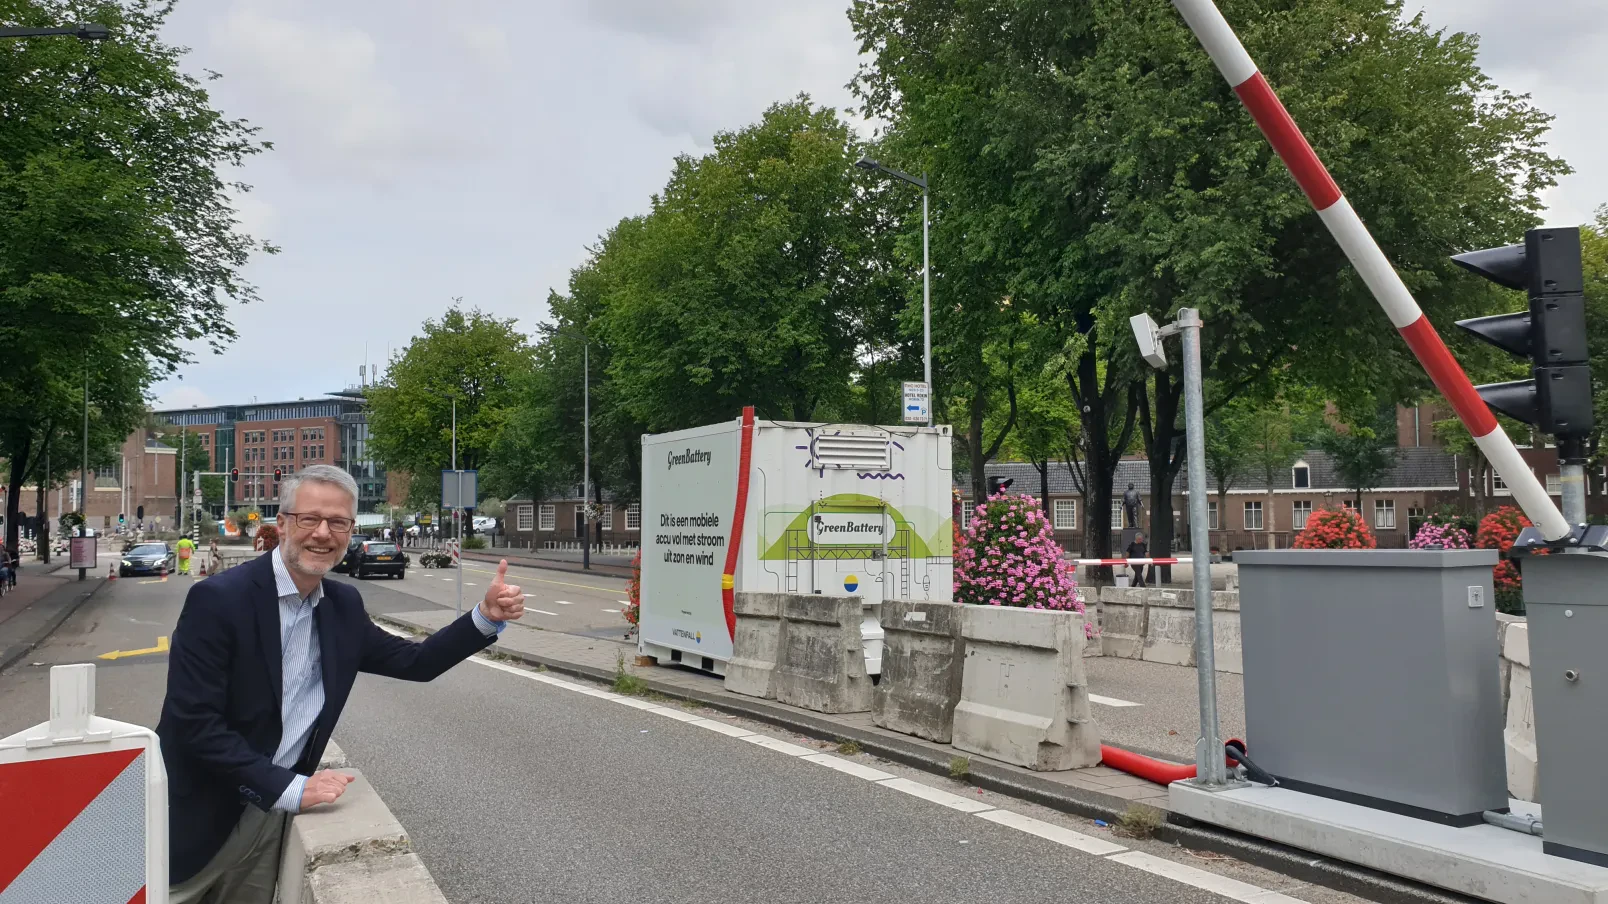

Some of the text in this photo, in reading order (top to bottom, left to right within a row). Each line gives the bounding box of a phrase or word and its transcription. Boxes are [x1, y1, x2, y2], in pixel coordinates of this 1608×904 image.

[668, 448, 711, 470] GreenBattery
[661, 512, 719, 527] Dit is een mobiele
[816, 520, 884, 535] GreenBattery
[656, 531, 724, 546] accu vol met stroom
[664, 549, 713, 565] uit zon en wind
[672, 628, 695, 640] VATTENFALL
